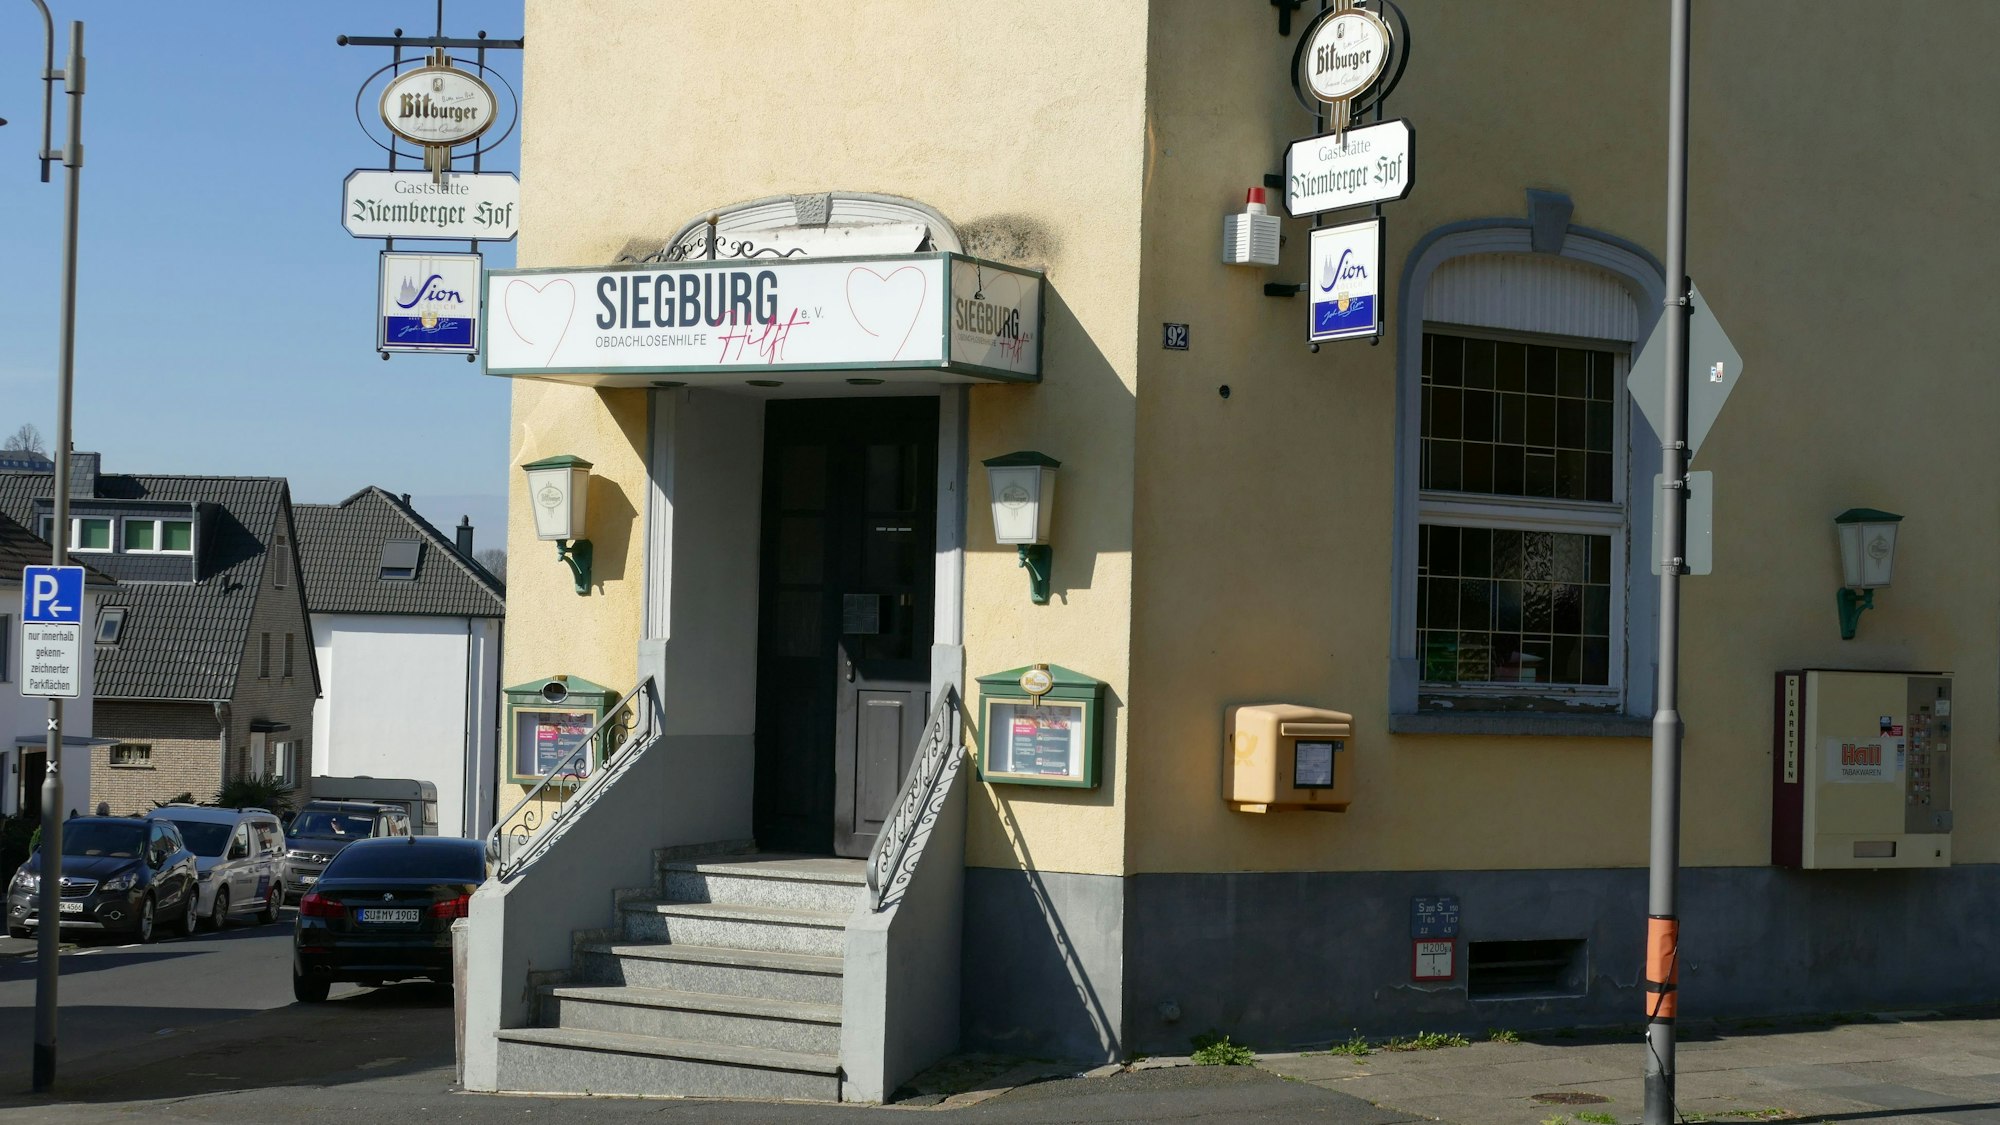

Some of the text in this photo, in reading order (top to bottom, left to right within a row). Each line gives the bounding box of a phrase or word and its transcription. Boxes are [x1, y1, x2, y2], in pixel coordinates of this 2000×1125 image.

[1316, 42, 1371, 75] Bitburger
[398, 92, 478, 122] Bitburger
[1318, 140, 1371, 161] Gaststätte
[394, 180, 469, 195] Gaststätte
[1290, 152, 1404, 199] Riemberger Hof
[352, 199, 514, 230] Riemberger Hof
[1321, 248, 1368, 292] Sion
[395, 274, 464, 309] Sion
[595, 270, 778, 330] SIEGBURG
[956, 297, 1019, 341] SIEGBURG
[595, 333, 707, 348] OBDACHLOSENHILFE
[715, 307, 810, 365] Hilft
[1167, 326, 1186, 346] 92
[32, 574, 58, 617] P
[28, 630, 74, 642] nur innerhalb
[36, 647, 65, 660] gekenn-
[29, 678, 70, 690] Parkflächen
[364, 910, 418, 920] SU MY 1903
